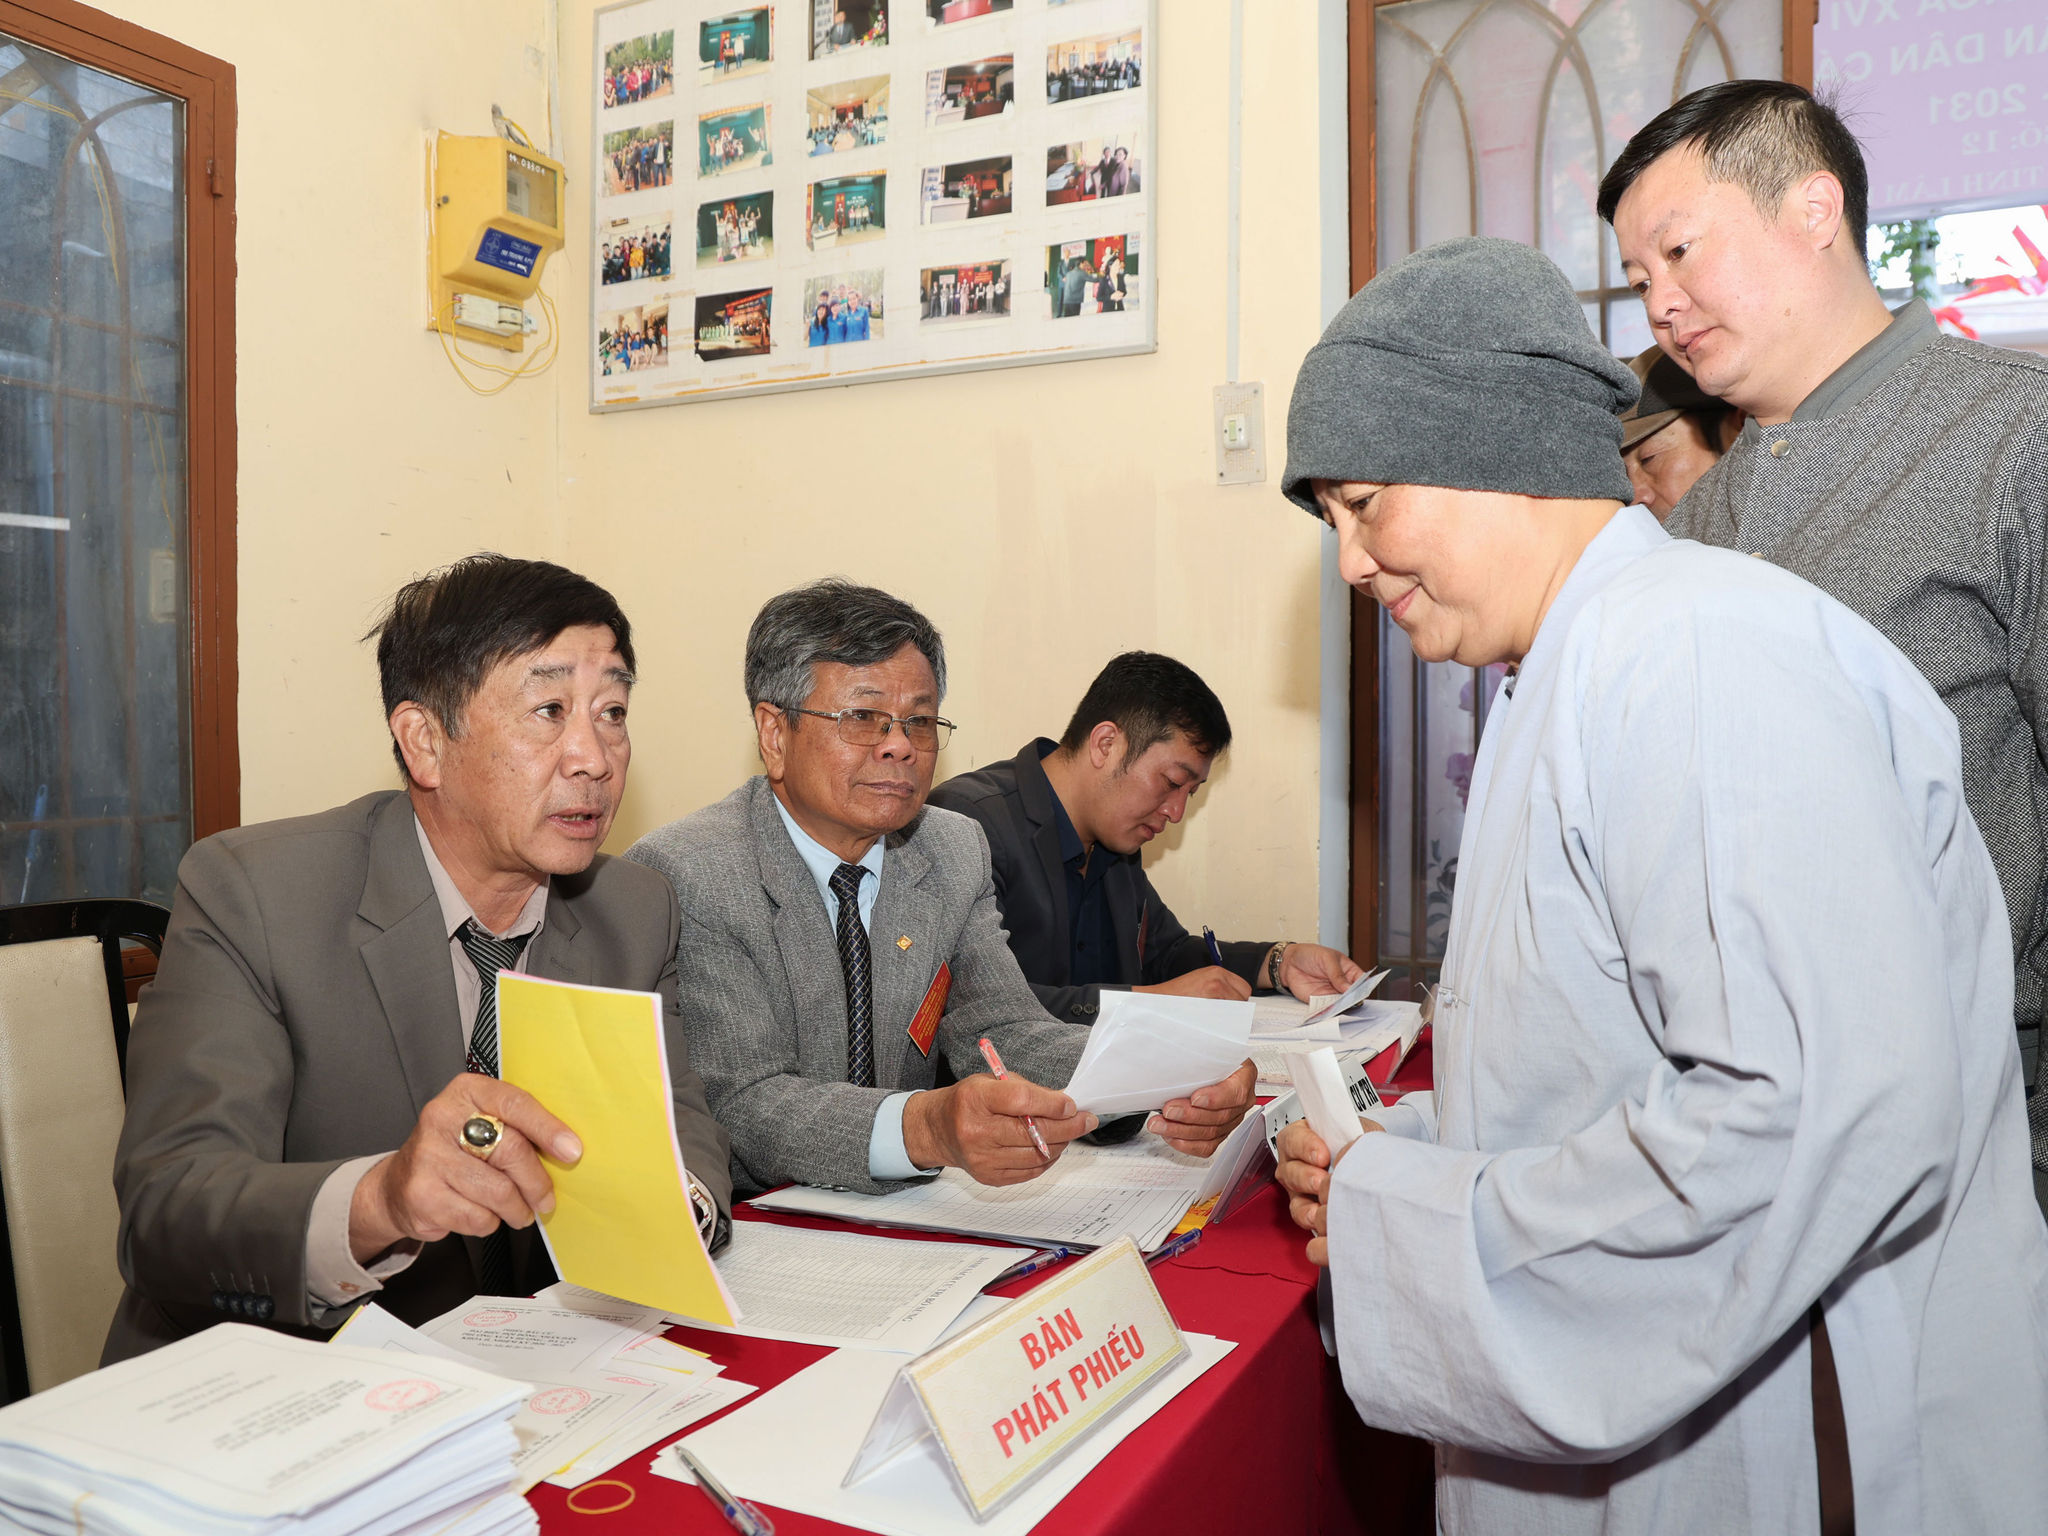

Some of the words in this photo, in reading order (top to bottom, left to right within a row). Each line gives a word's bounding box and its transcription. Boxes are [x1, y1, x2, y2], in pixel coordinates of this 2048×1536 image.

[1019, 1308, 1083, 1371] BÀN
[992, 1378, 1070, 1459] PHÁT
[1068, 1323, 1145, 1402] PHIẾU
